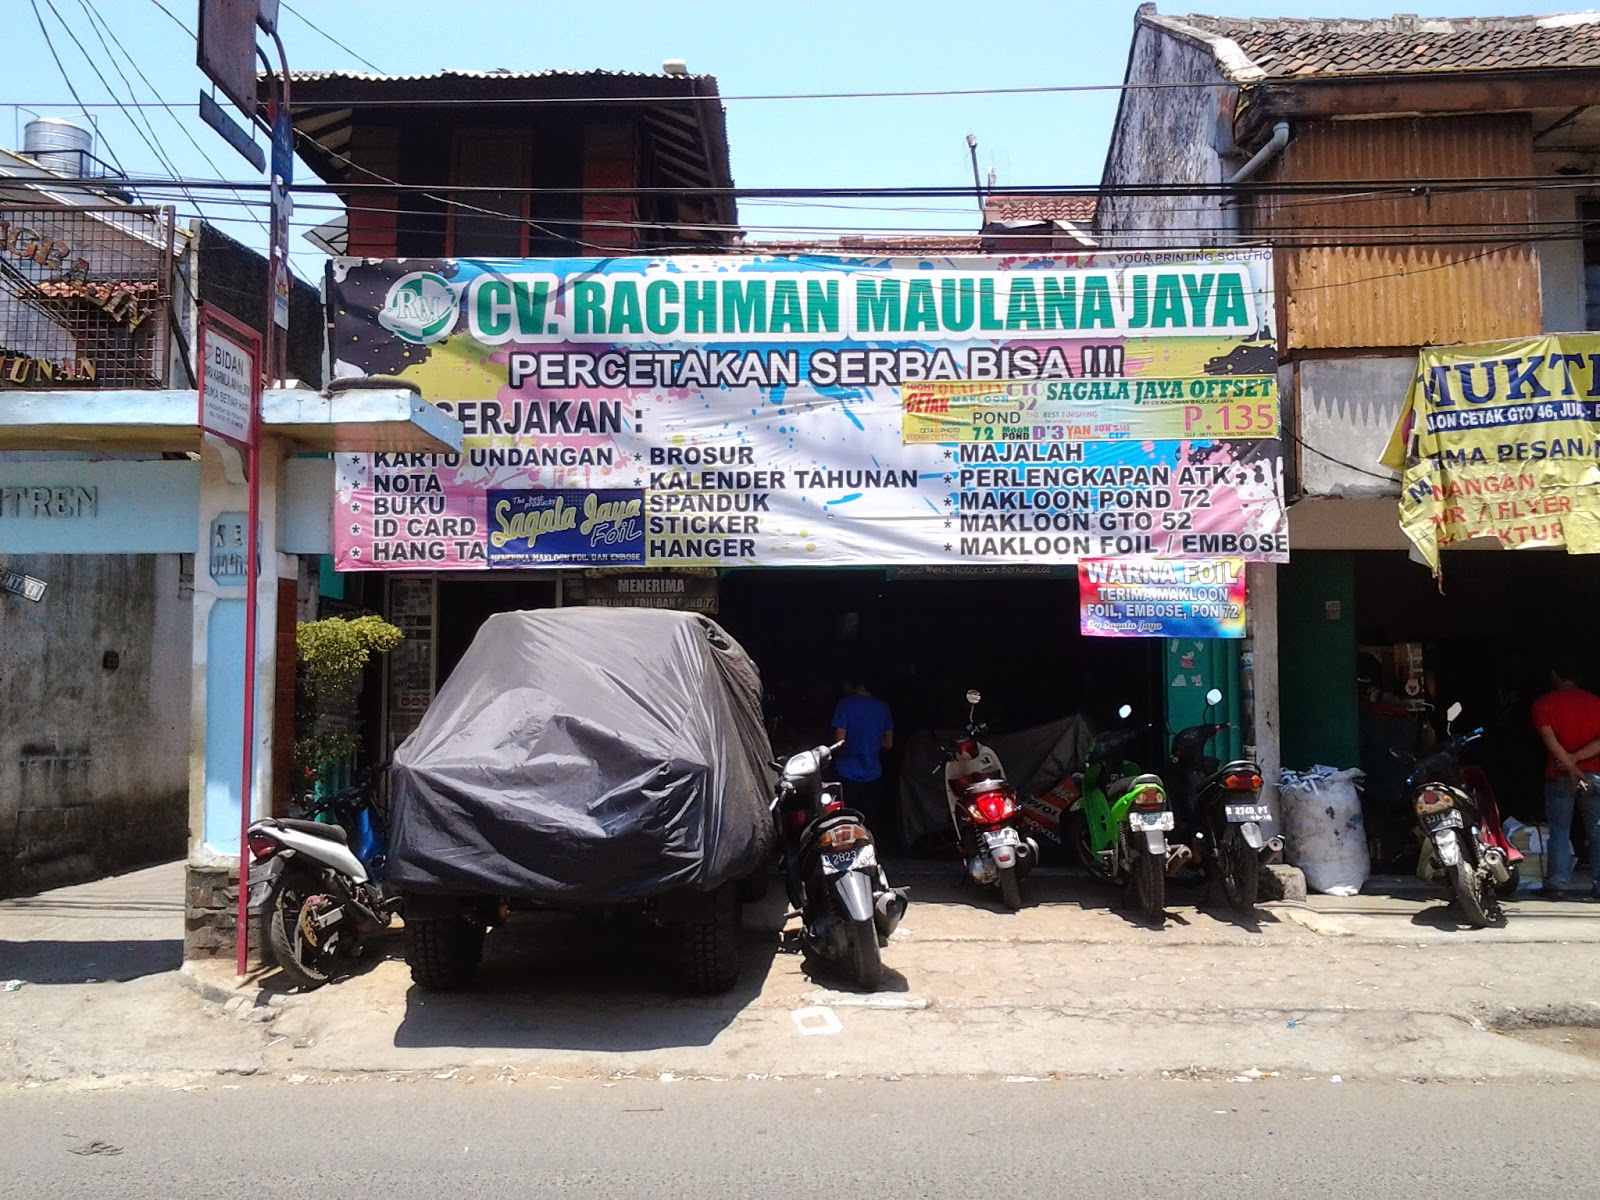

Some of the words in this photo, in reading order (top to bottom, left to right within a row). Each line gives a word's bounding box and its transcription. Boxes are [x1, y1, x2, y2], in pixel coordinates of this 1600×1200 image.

[1117, 253, 1151, 264] YOUR
[1156, 252, 1213, 263] PRINTING
[476, 280, 558, 335] CV.
[573, 279, 838, 334] RACHMAN
[856, 275, 1115, 333] MAULANA
[1128, 272, 1248, 328] JAYA
[215, 346, 243, 377] BIDAN
[510, 350, 800, 388] PERCETAKAN
[809, 349, 960, 387] SERBA
[967, 347, 1075, 381] BISA
[1047, 382, 1130, 401] SAGALA
[1135, 380, 1183, 404] JAYA
[1190, 379, 1273, 399] OFFSET
[973, 411, 1021, 424] POND
[1062, 410, 1098, 418] FINISHING
[1184, 404, 1273, 431] P.135
[1460, 408, 1505, 427] CETAK
[1508, 405, 1534, 421] GTO
[1538, 404, 1558, 420] 46,
[973, 426, 994, 440] 72
[1066, 425, 1091, 439] YAN
[374, 451, 460, 468] KARTU
[470, 447, 613, 468] UNDANGAN
[650, 446, 754, 466] BROSUR
[960, 443, 1083, 462] MAJALAH
[1497, 437, 1600, 463] PESAN
[374, 474, 442, 494] NOTA
[650, 470, 786, 491] KALENDER
[794, 469, 918, 489] TAHUNAN
[960, 466, 1169, 488] PERLENGKAPAN
[1178, 464, 1231, 486] ATK
[0, 485, 98, 518] TREN
[374, 496, 445, 516] BUKU
[650, 493, 771, 513] SPANDUK
[960, 489, 1089, 510] MAKLOON
[1100, 489, 1171, 509] POND
[1181, 488, 1211, 509] 72
[1498, 495, 1571, 519] FLYER
[374, 518, 401, 538] ID
[407, 517, 476, 538] CARD
[491, 496, 577, 548] Sagala
[580, 492, 642, 535] Jaya
[650, 514, 759, 535] STICKER
[960, 511, 1089, 532] MAKLOON
[1100, 511, 1154, 531] GTO
[1162, 511, 1192, 531] 52
[374, 540, 446, 561] HANG
[650, 538, 756, 559] HANGER
[960, 535, 1089, 556] MAKLOON
[1100, 534, 1158, 555] FOIL
[1183, 533, 1287, 554] EMBOSE
[1086, 562, 1177, 585] WARNA
[1183, 561, 1239, 584] FOIL
[618, 579, 685, 593] MENERIMA
[1098, 587, 1153, 601] TERIMA
[1154, 587, 1229, 601] MAKLOON
[1086, 603, 1122, 619] FOIL,
[1126, 603, 1187, 620] EMBOSE,
[1191, 603, 1219, 618] PON
[1223, 604, 1239, 619] 72
